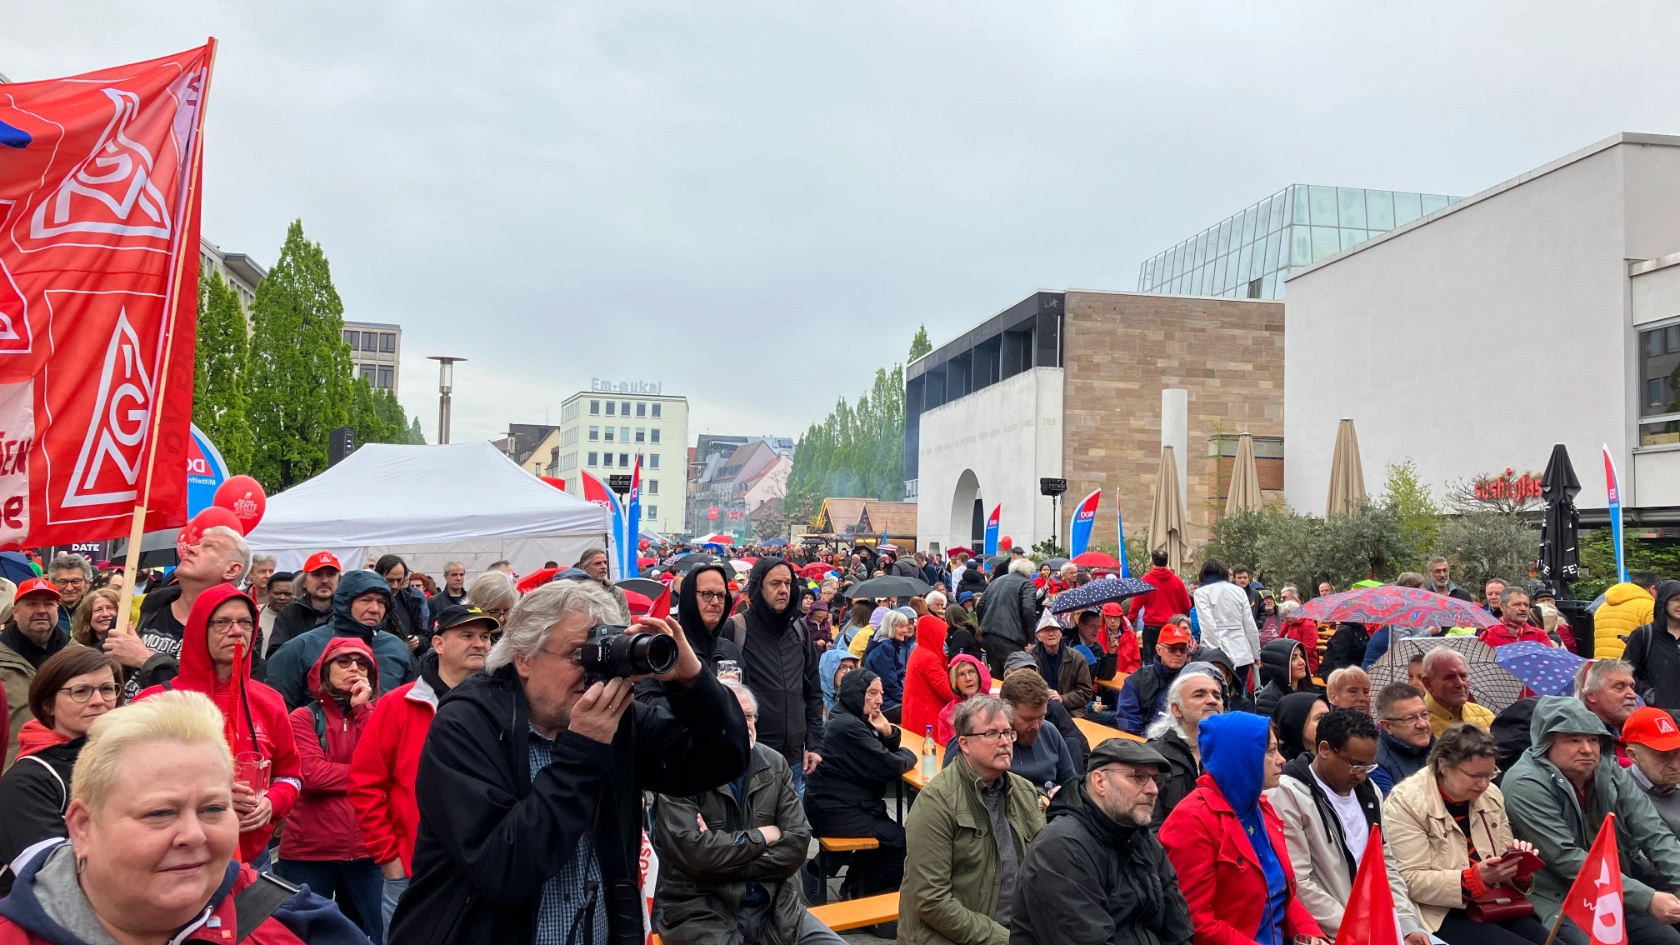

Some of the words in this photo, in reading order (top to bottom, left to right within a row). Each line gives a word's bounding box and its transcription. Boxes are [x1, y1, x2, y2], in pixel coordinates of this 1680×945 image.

[1474, 468, 1512, 499] sushi
[234, 501, 258, 510] RENTE
[71, 543, 100, 552] DATE
